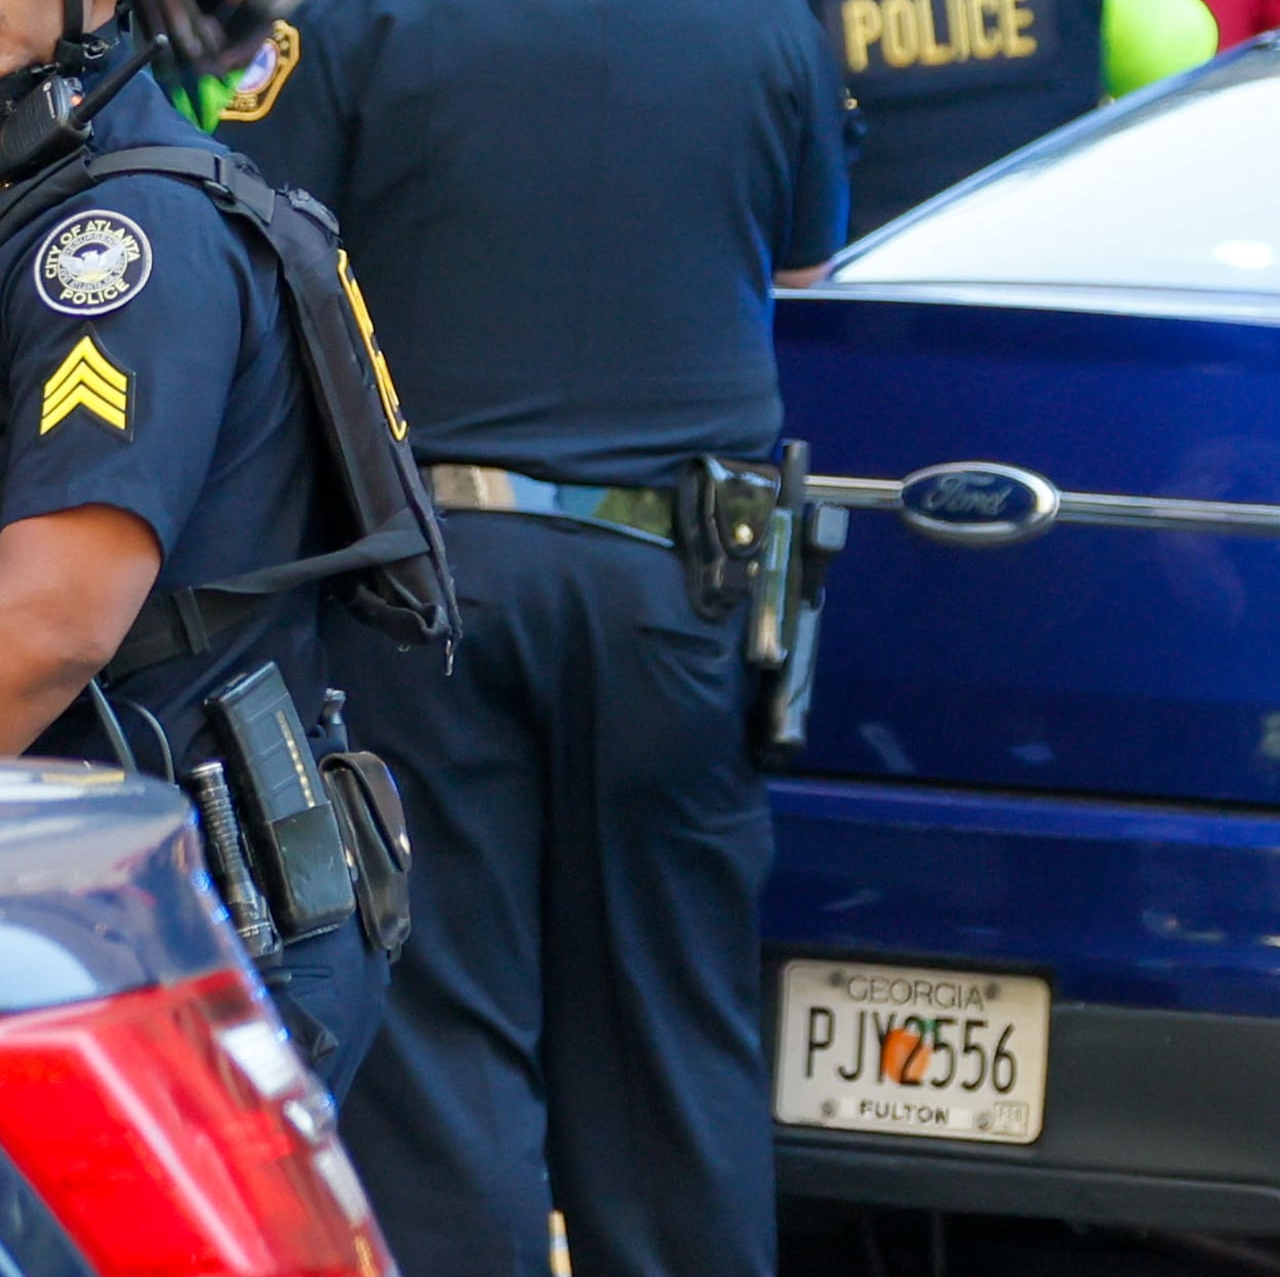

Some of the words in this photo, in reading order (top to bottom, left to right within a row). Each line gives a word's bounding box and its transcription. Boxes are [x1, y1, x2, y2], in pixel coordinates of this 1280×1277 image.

[45, 245, 59, 279] CITY
[60, 224, 82, 245] OF
[85, 219, 142, 263] ATLANTA
[59, 278, 131, 305] POLICE
[926, 472, 1014, 517] Ford
[845, 975, 986, 1011] GEORGIA
[859, 1099, 951, 1126] FULTON
